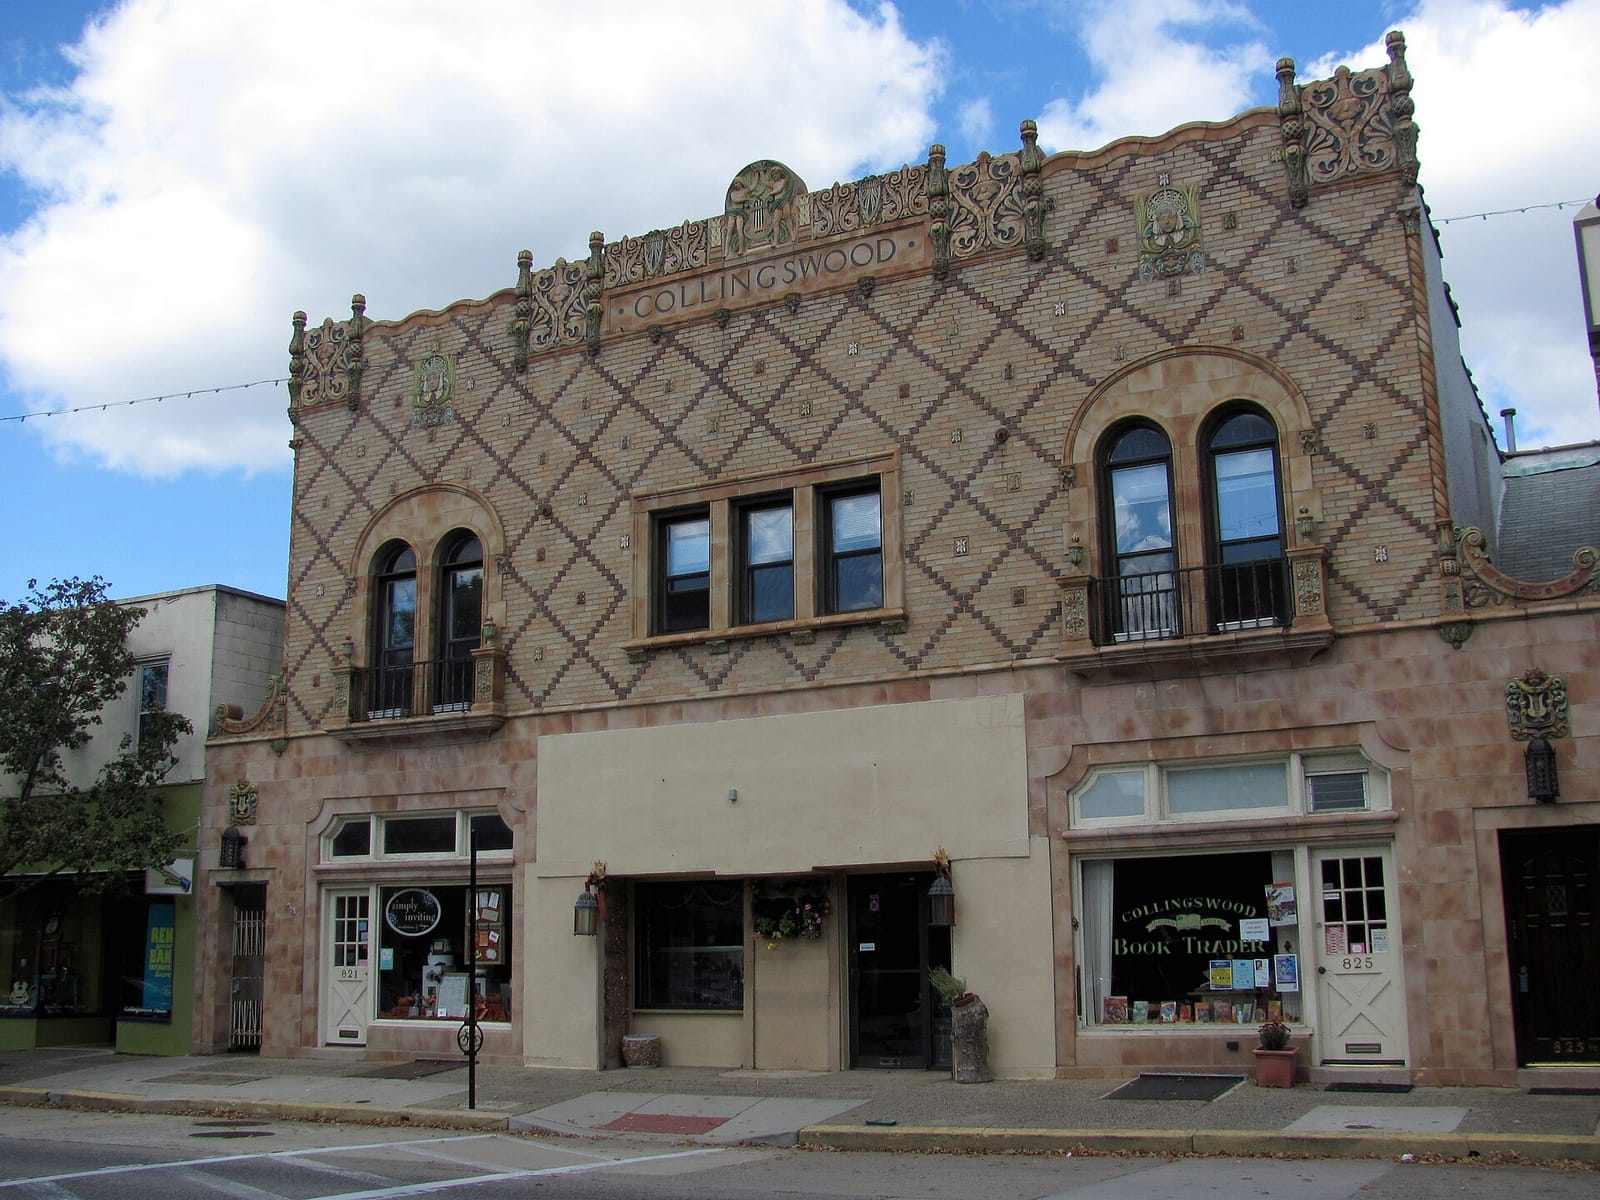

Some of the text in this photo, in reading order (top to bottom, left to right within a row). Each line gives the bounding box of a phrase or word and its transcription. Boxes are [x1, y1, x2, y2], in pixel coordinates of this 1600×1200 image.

[633, 237, 897, 318] COLLINGSWOOD
[392, 896, 418, 912] simply
[1121, 896, 1257, 923] COLLINGSWOOD
[404, 911, 437, 923] inviting
[1114, 936, 1266, 956] BOOK TRADER
[1342, 957, 1378, 969] 825
[341, 969, 358, 979] 821
[1553, 1040, 1585, 1054] 825
